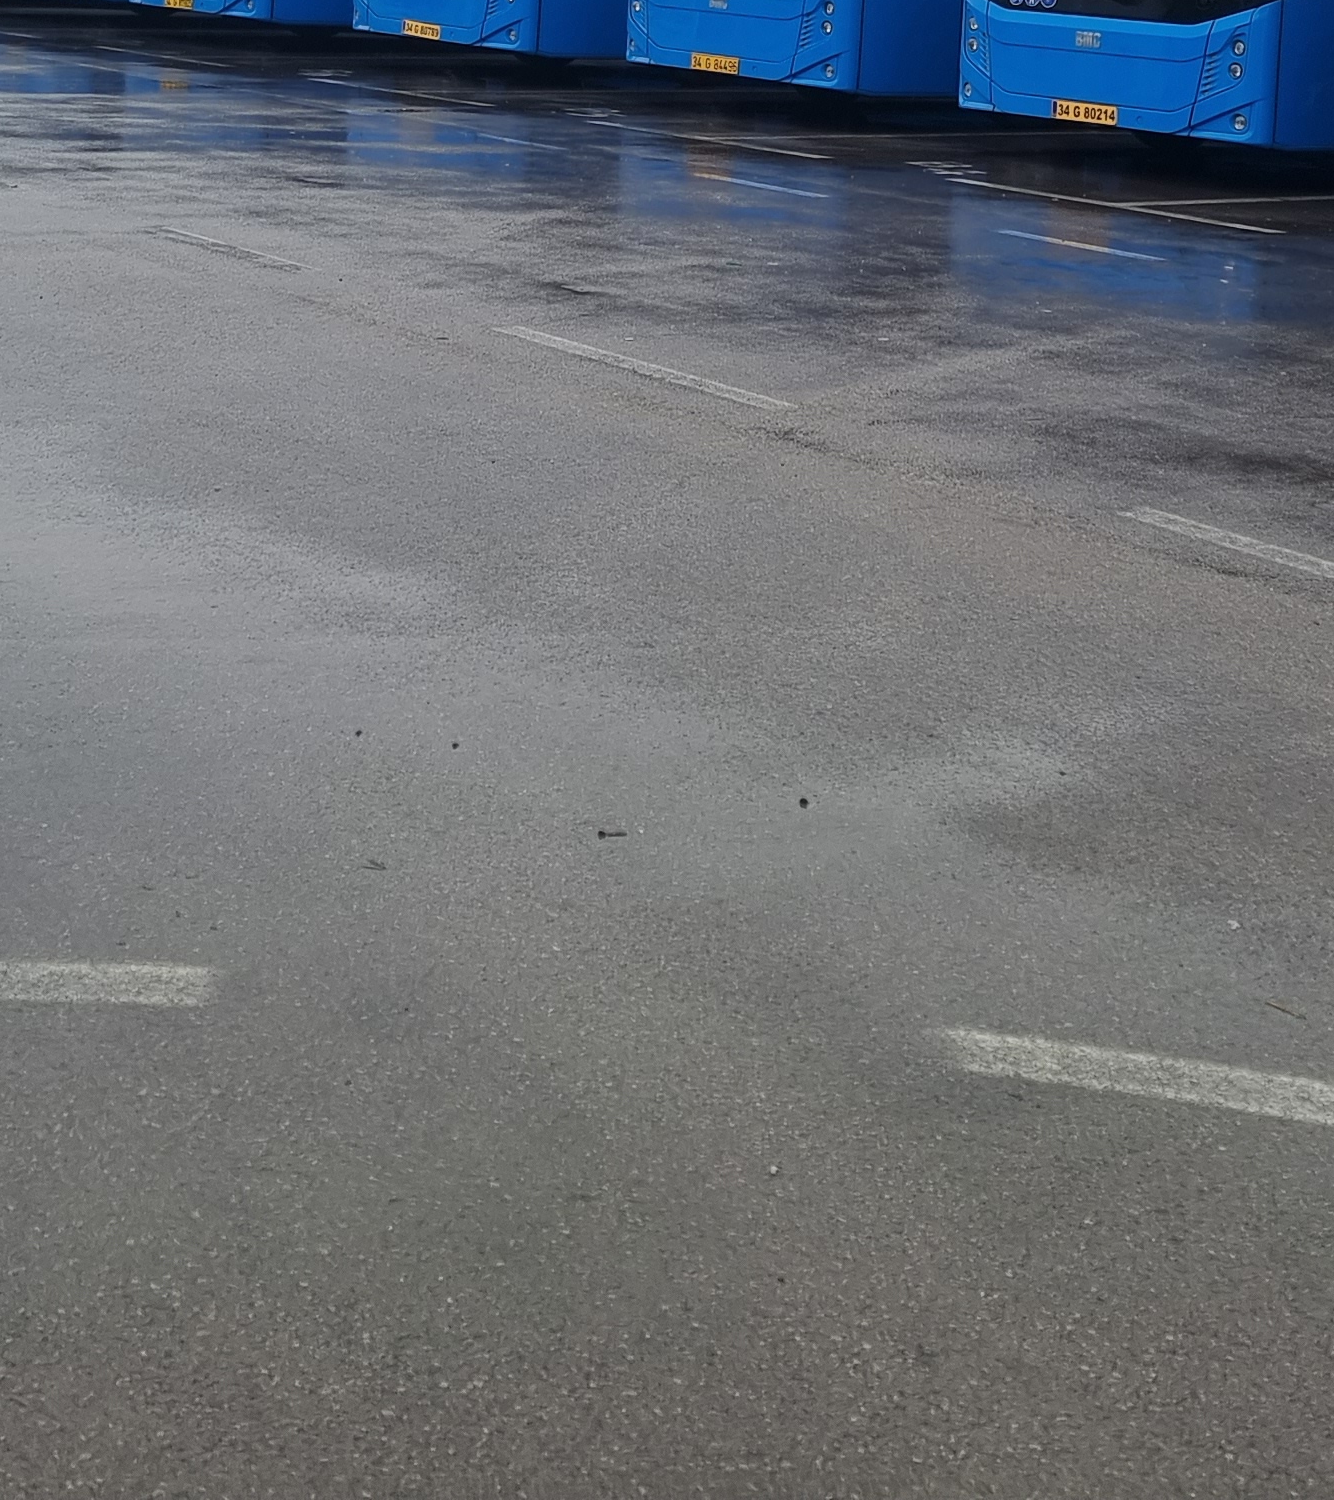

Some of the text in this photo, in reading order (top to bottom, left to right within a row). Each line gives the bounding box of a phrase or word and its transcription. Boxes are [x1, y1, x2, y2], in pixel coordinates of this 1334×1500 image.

[692, 55, 702, 68] 34
[705, 57, 711, 69] G
[1058, 103, 1116, 122] 34 G 80214
